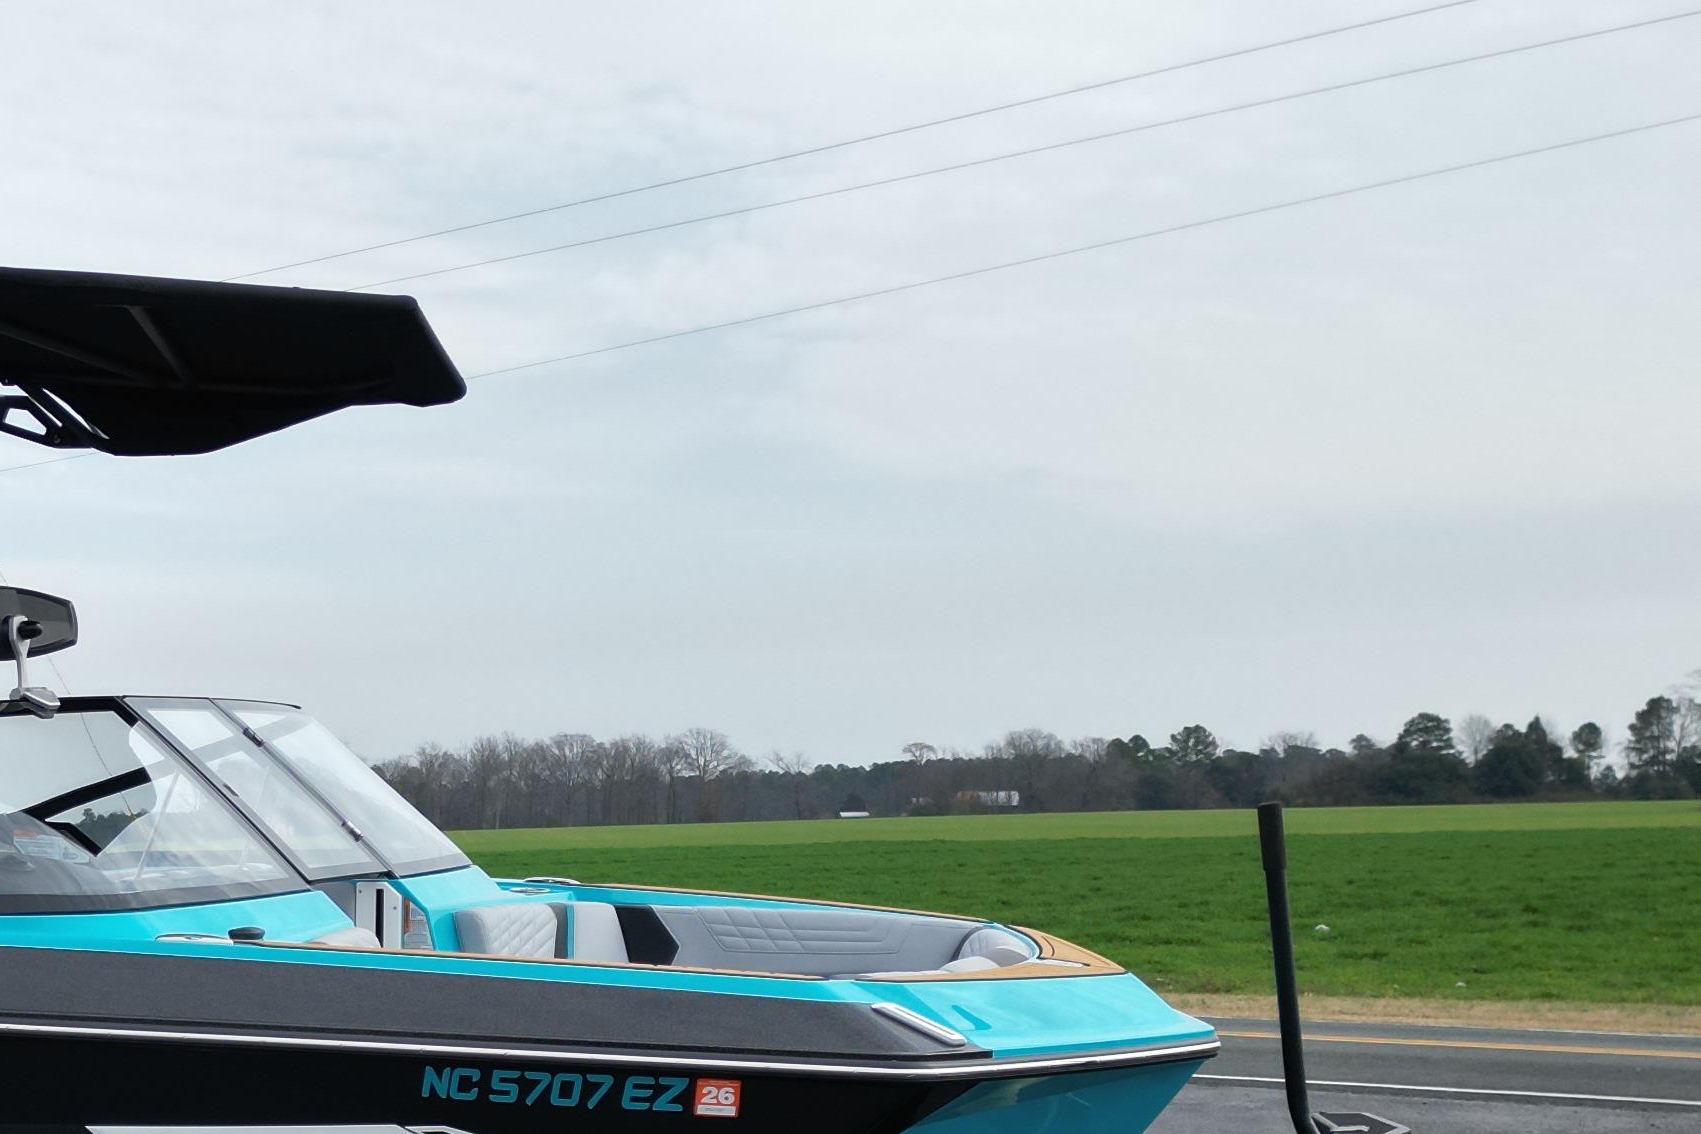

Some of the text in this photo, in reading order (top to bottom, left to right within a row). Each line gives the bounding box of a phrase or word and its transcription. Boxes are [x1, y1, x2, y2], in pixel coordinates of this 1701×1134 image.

[421, 1065, 690, 1112] NC 5707 EZ
[700, 1086, 736, 1105] 26
